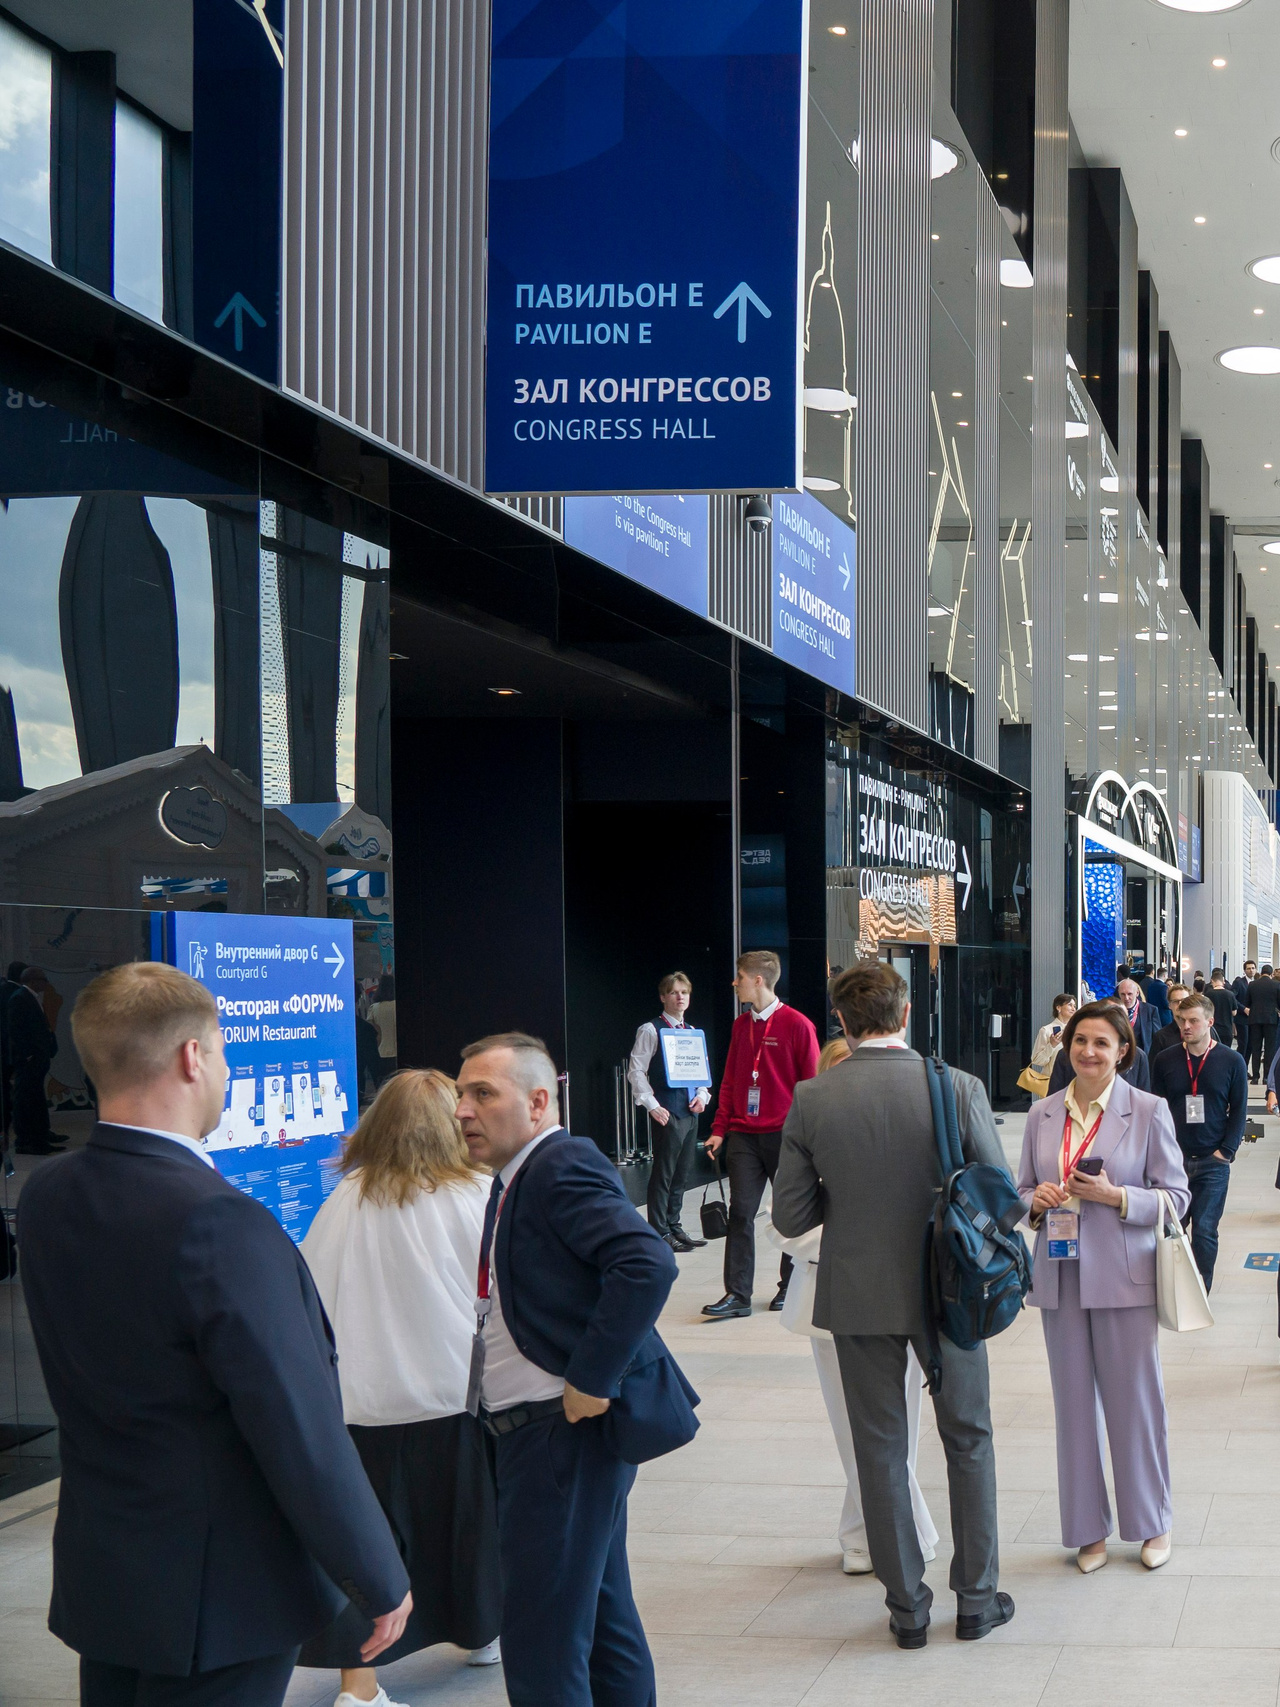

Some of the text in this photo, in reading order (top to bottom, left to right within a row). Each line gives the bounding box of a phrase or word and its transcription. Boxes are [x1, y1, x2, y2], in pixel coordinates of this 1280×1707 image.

[515, 282, 704, 308] ПАВИЛЬОН E
[515, 322, 652, 345] PAVILION E
[513, 376, 772, 404] ЗАЛ КОНГРЕССОВ
[513, 418, 716, 441] CONGRESS HALL
[615, 510, 670, 558] is via pavilion E
[624, 495, 632, 510] to
[633, 498, 646, 519] the
[646, 506, 677, 538] Congress
[677, 526, 691, 548] Hall
[779, 499, 831, 559] ПАВИЛЬОН E
[779, 532, 817, 576] PAVILION E
[779, 572, 851, 640] ЗАЛ КОНГРЕССОВ
[779, 609, 836, 660] CONGRESS HALL
[859, 813, 957, 873] ЗАЛ КОНГРЕССОВ
[860, 868, 930, 907] CONGRESS HALL
[215, 942, 318, 963] Внутренний двор G
[216, 965, 268, 982] Courtyard G
[217, 993, 344, 1020] Ресторан «ФОРУМ»
[263, 1024, 317, 1041] Restaurant
[303, 1060, 309, 1070] G
[328, 1059, 334, 1067] H
